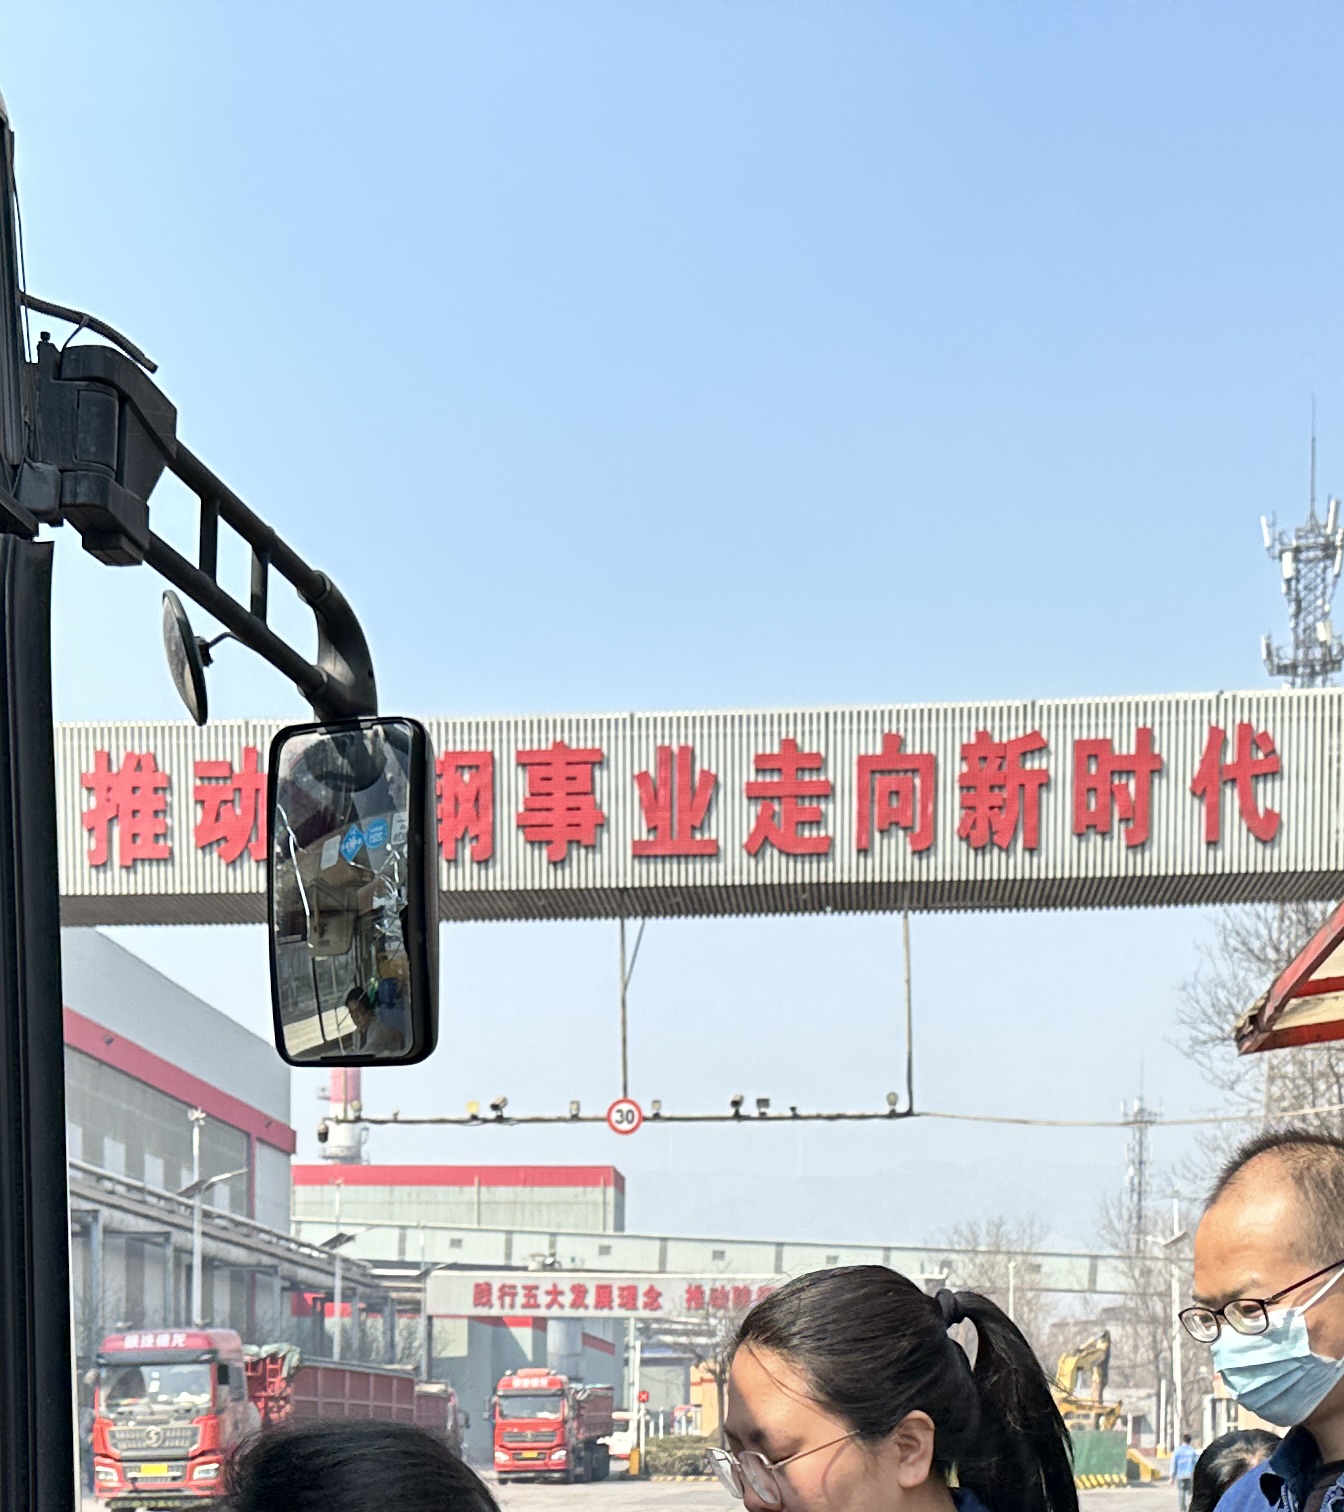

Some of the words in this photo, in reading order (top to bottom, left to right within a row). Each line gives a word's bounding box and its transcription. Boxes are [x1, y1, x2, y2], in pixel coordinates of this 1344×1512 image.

[615, 1108, 635, 1125] 30
[472, 1282, 662, 1310] 践行五大发展理念
